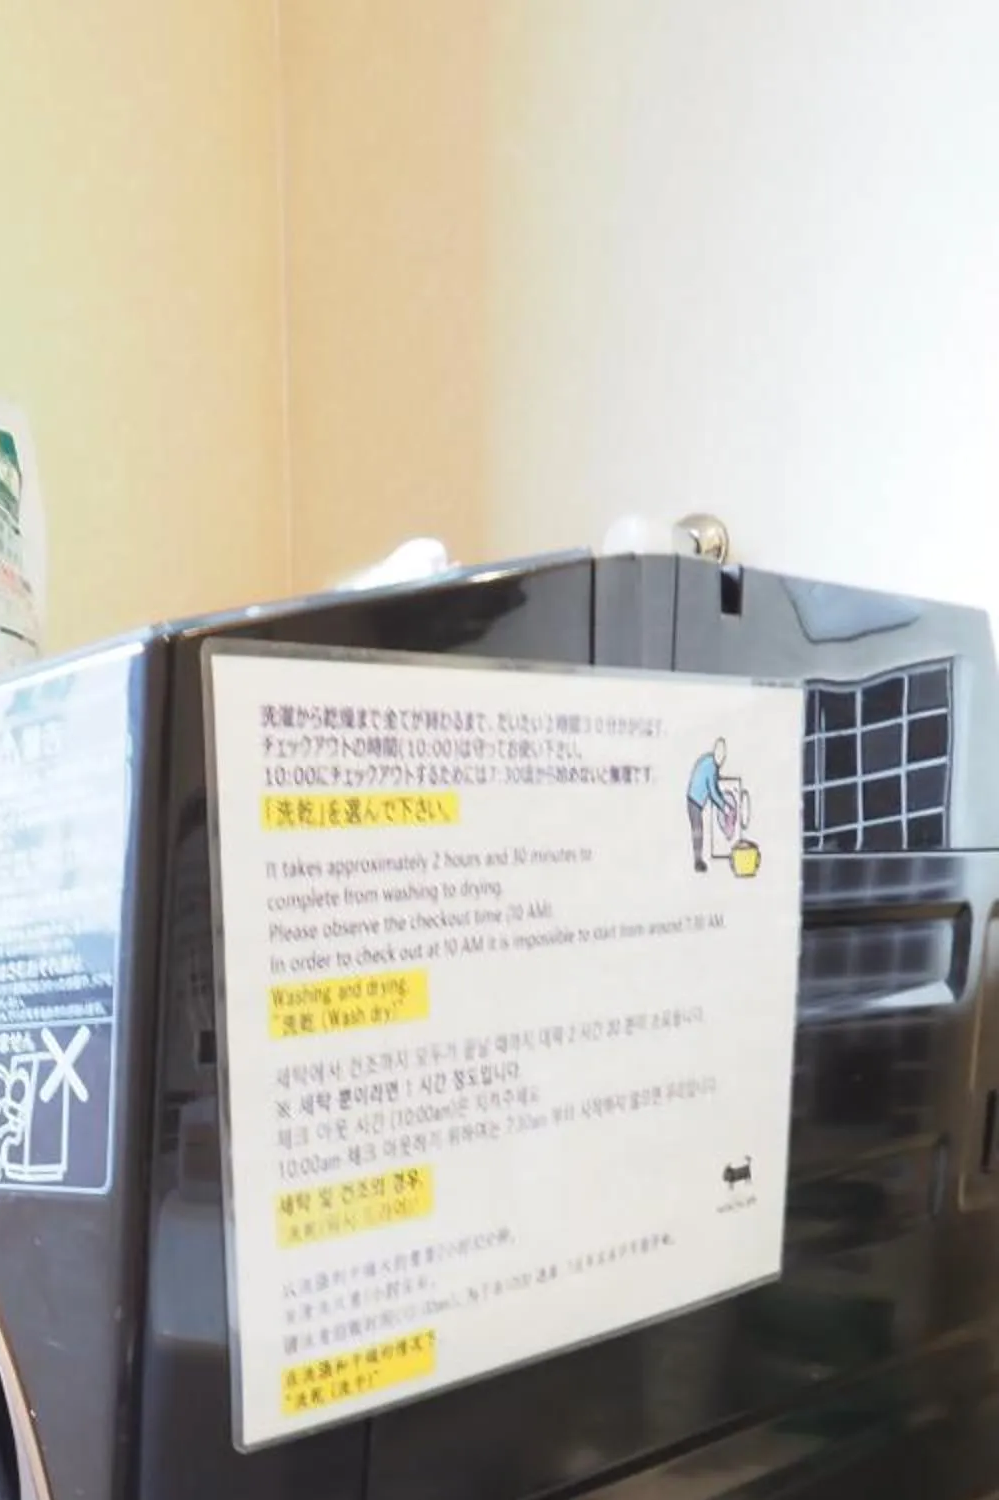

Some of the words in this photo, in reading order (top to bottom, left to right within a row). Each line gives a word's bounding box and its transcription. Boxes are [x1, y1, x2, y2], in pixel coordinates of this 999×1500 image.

[282, 857, 323, 879] takes
[327, 853, 428, 881] approximately
[444, 852, 482, 869] hours
[485, 848, 508, 866] and
[267, 891, 340, 913] complete
[344, 886, 379, 905] from
[382, 883, 439, 906] washing
[443, 881, 457, 898] to
[268, 922, 318, 943] Please
[322, 918, 381, 939] observe
[384, 914, 407, 932] the
[290, 951, 331, 972] order
[336, 950, 352, 967] to
[355, 945, 396, 966] check
[400, 944, 423, 961] out
[271, 984, 333, 1008] Washing
[337, 980, 363, 1001] and
